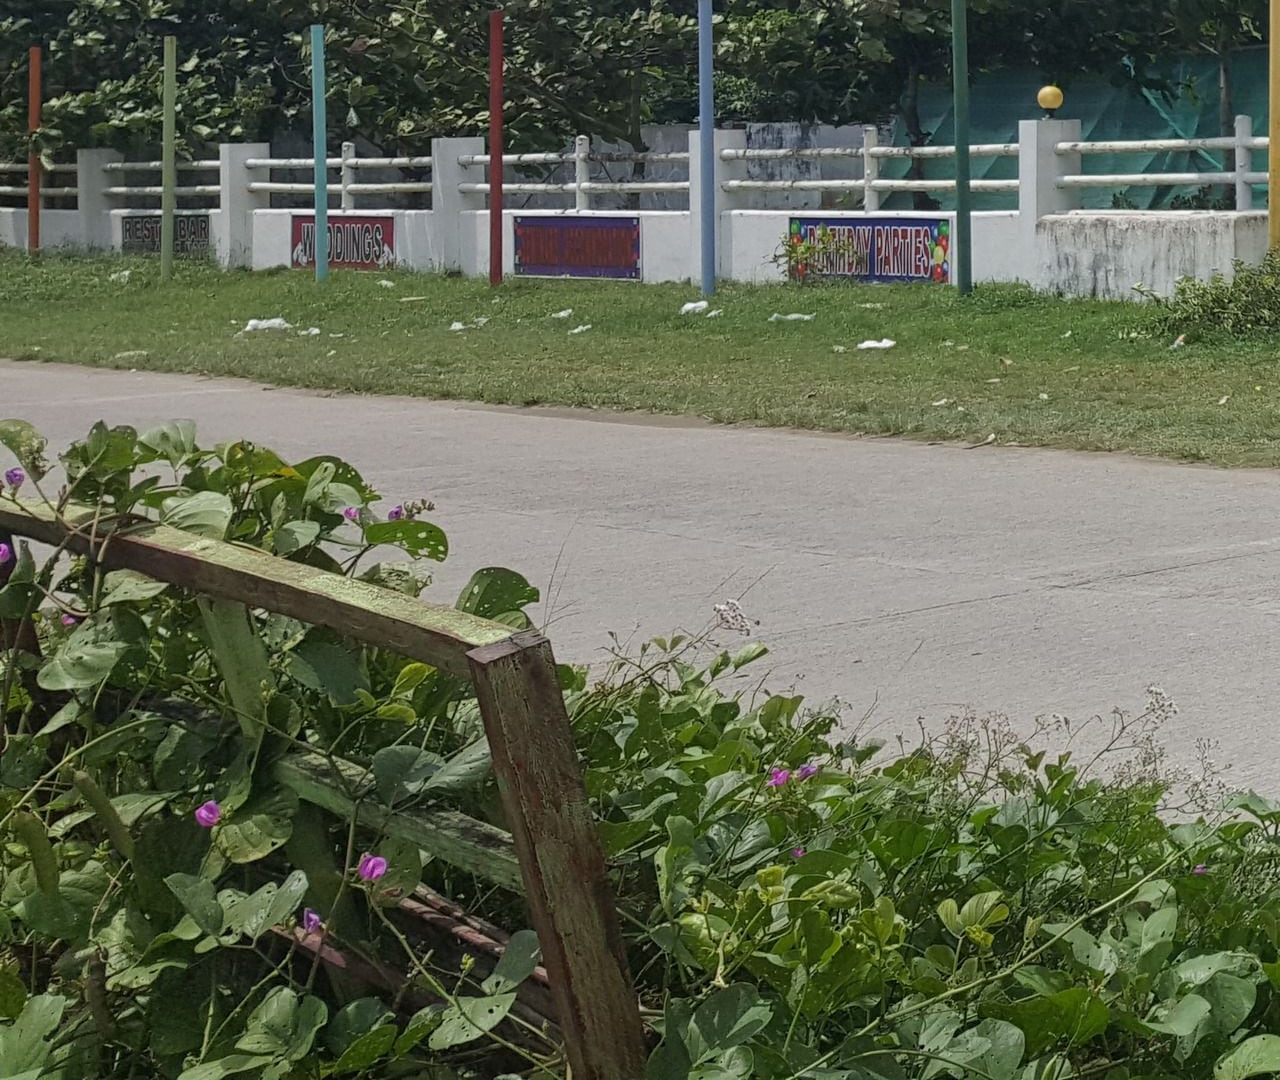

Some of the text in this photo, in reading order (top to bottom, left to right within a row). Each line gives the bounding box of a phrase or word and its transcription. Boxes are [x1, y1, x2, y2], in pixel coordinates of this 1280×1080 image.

[124, 217, 208, 241] REST BAR
[301, 223, 382, 263] WDDINGS
[874, 226, 931, 278] PARTIES
